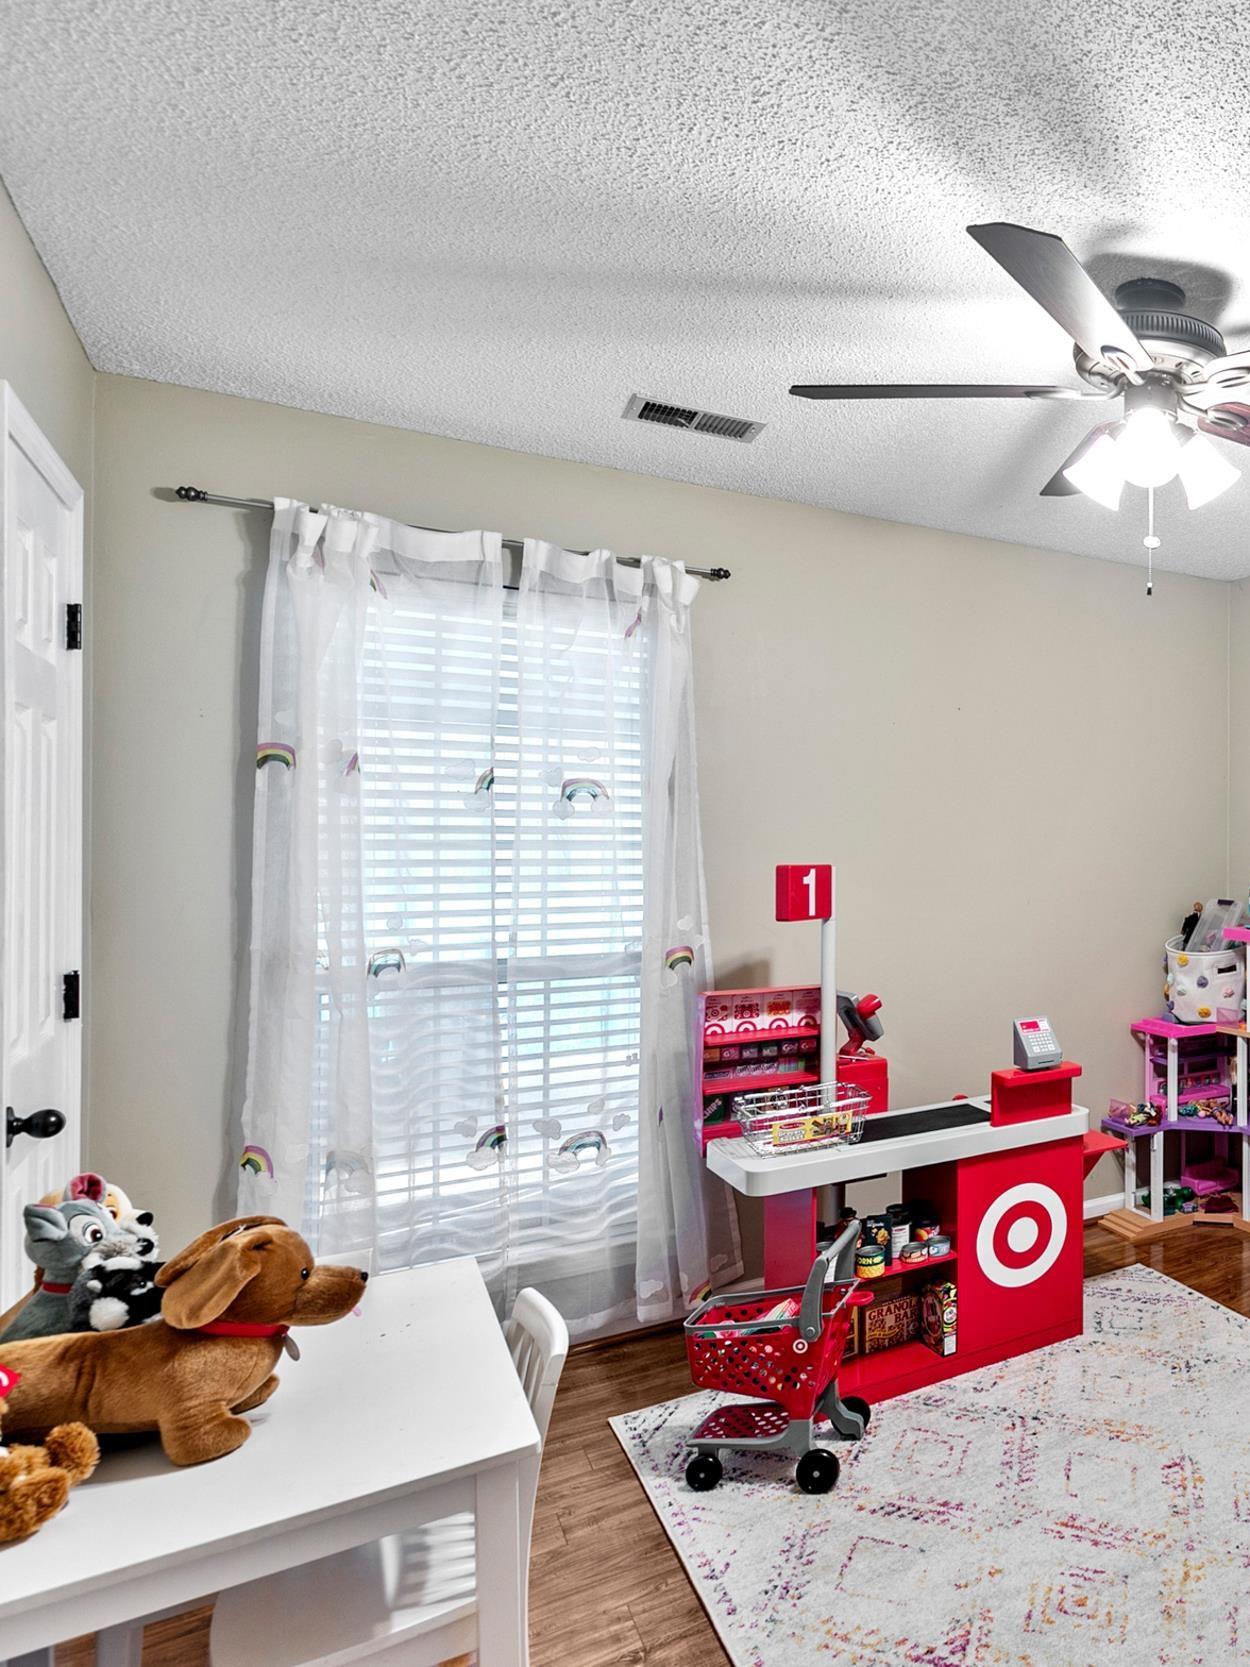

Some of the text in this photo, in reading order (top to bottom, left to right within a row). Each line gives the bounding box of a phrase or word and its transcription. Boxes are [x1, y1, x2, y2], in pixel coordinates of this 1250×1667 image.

[802, 868, 816, 916] 1
[856, 1256, 873, 1265] ORN
[868, 1300, 916, 1320] GRANOL
